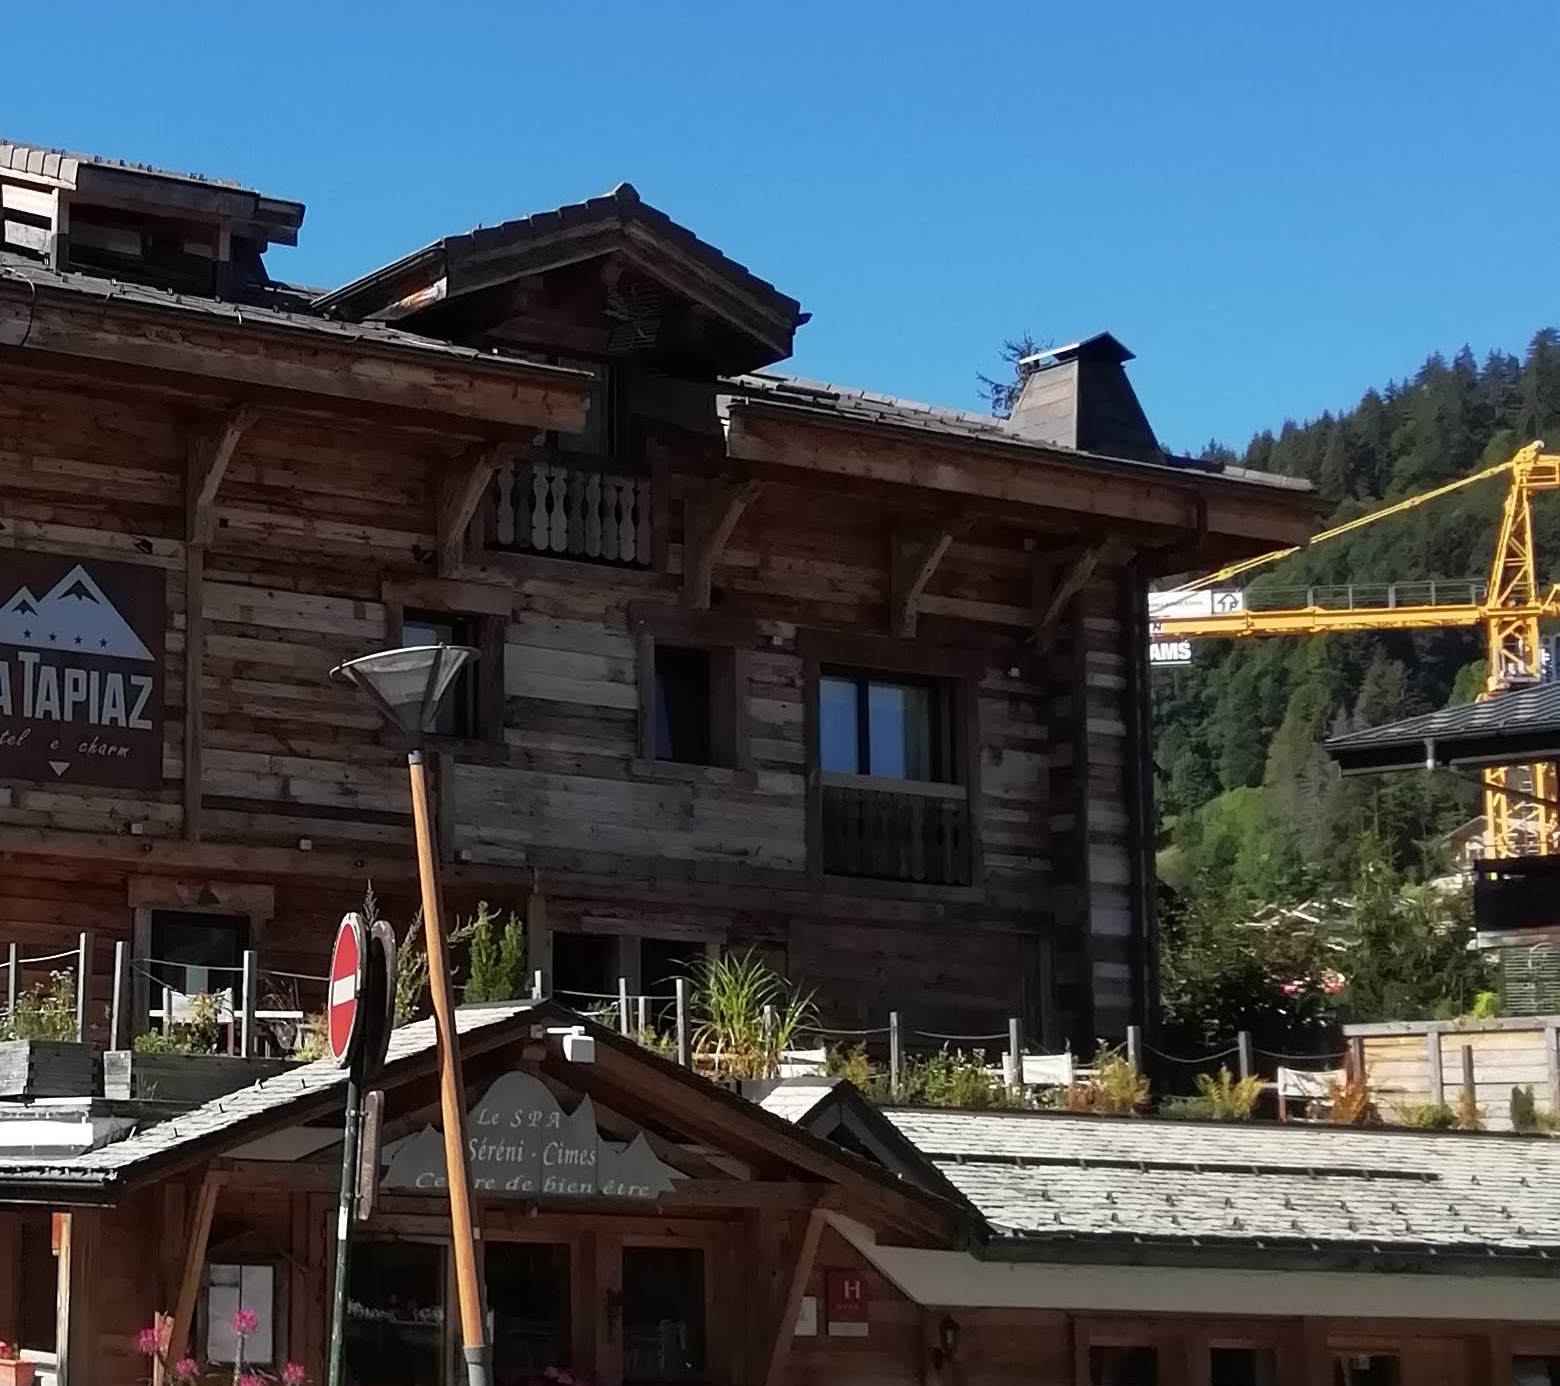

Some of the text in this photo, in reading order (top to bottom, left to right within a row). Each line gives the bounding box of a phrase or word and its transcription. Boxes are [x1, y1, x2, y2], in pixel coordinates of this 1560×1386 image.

[18, 651, 154, 730] TAPIAZ
[78, 735, 131, 757] charm
[477, 1108, 561, 1129] Le SPA
[468, 1138, 524, 1162] Séréni
[543, 1141, 597, 1166] Cimes
[416, 1172, 651, 1198] Cere de bien être
[844, 1280, 861, 1299] H
